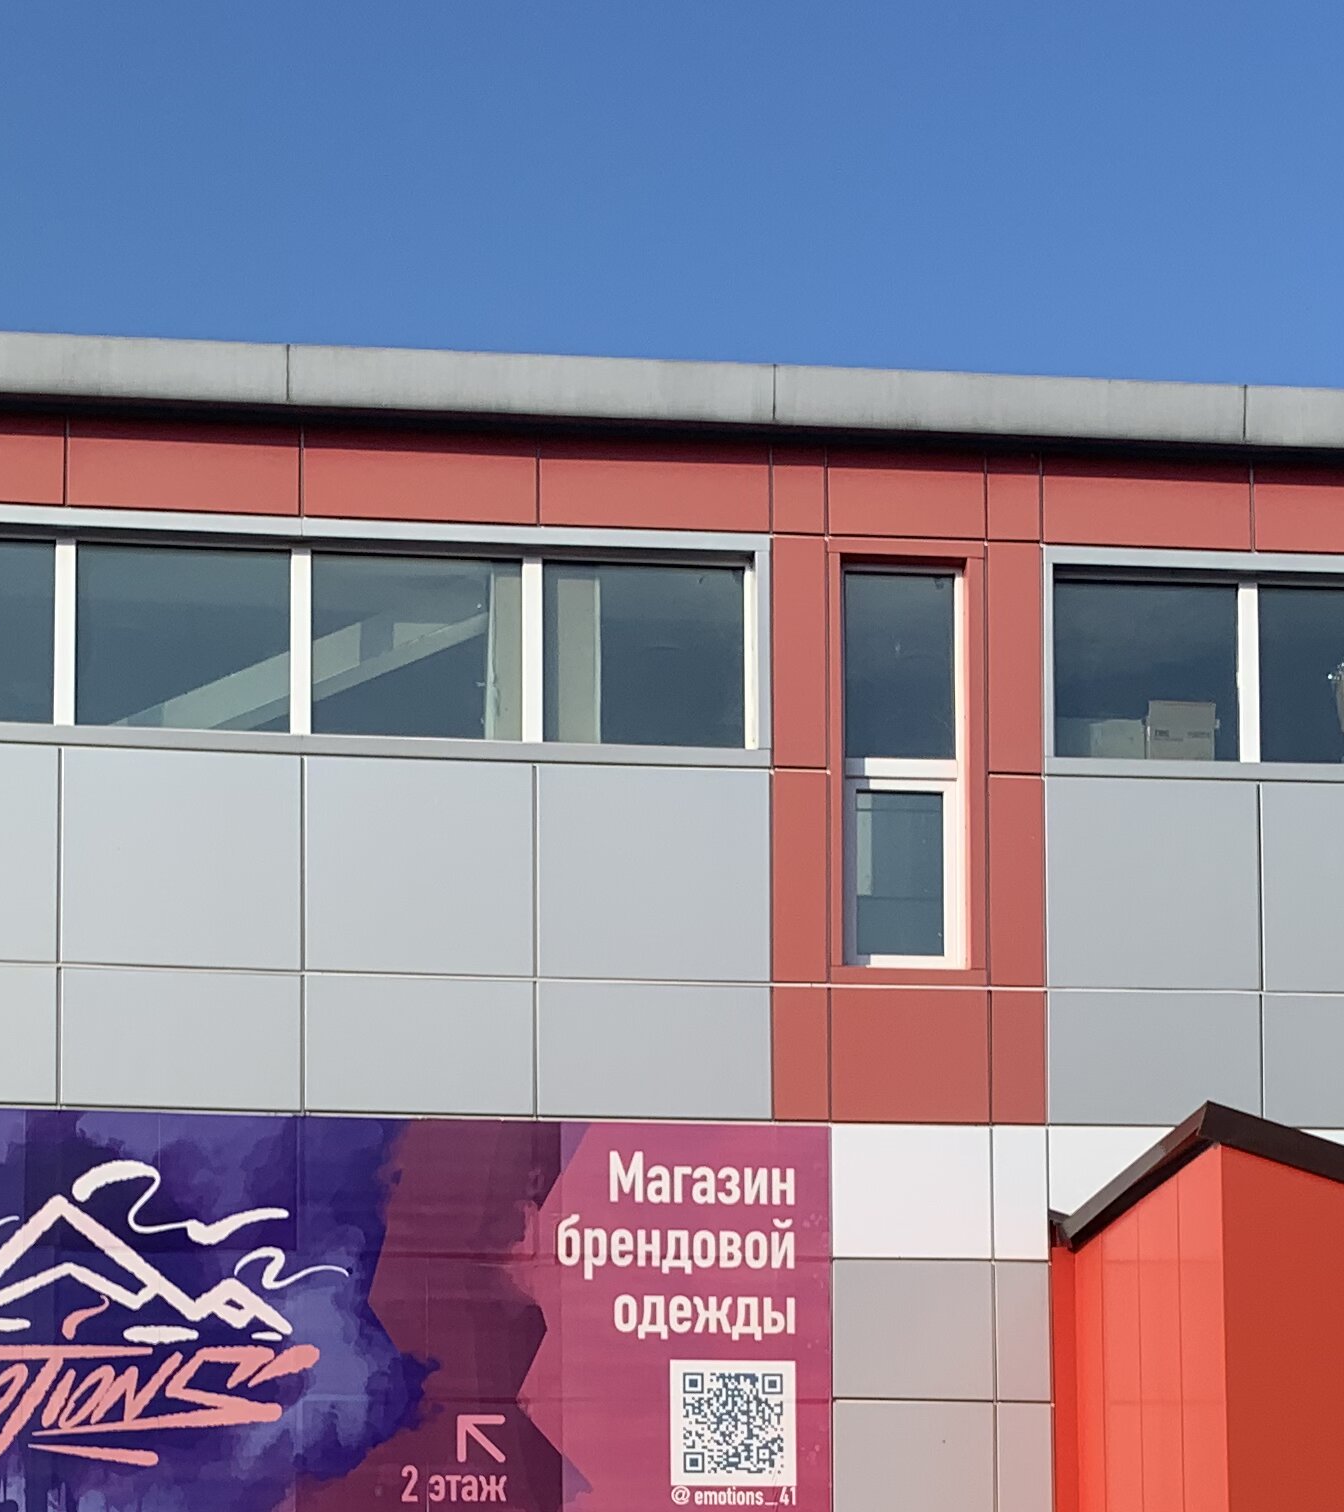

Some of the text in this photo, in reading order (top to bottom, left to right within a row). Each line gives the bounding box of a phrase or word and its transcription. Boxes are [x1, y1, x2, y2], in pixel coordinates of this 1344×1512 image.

[609, 1151, 795, 1205] Магазин
[557, 1214, 795, 1280] брендовой
[614, 1294, 795, 1341] одежды
[401, 1465, 507, 1502] 2 этаж
